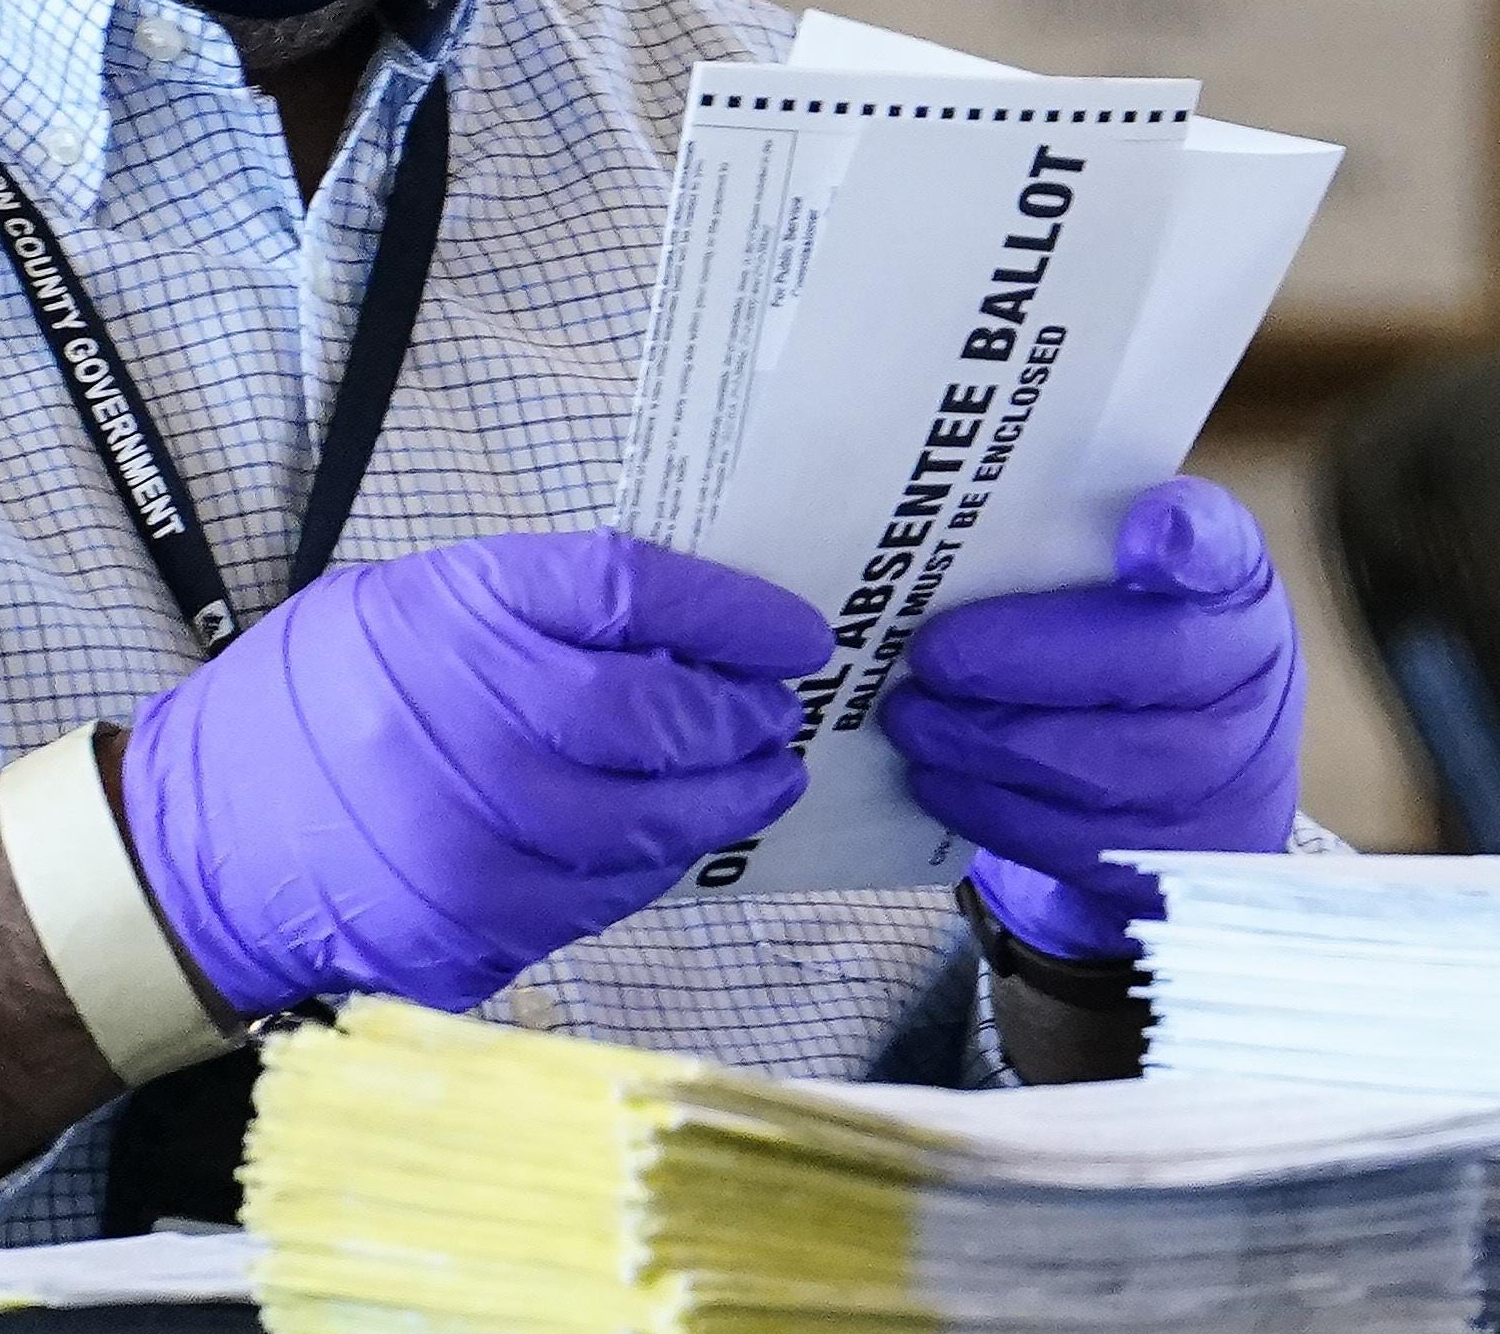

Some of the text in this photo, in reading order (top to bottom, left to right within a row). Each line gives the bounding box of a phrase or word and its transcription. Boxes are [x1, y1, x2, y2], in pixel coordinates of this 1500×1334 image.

[4, 216, 88, 330] COUNTY
[63, 336, 186, 541] GOVERNMENT
[833, 324, 1068, 731] BALLOT MUST BE ENCLOSED
[834, 383, 999, 649] ABSENTEE
[959, 144, 1087, 363] BALLOT
